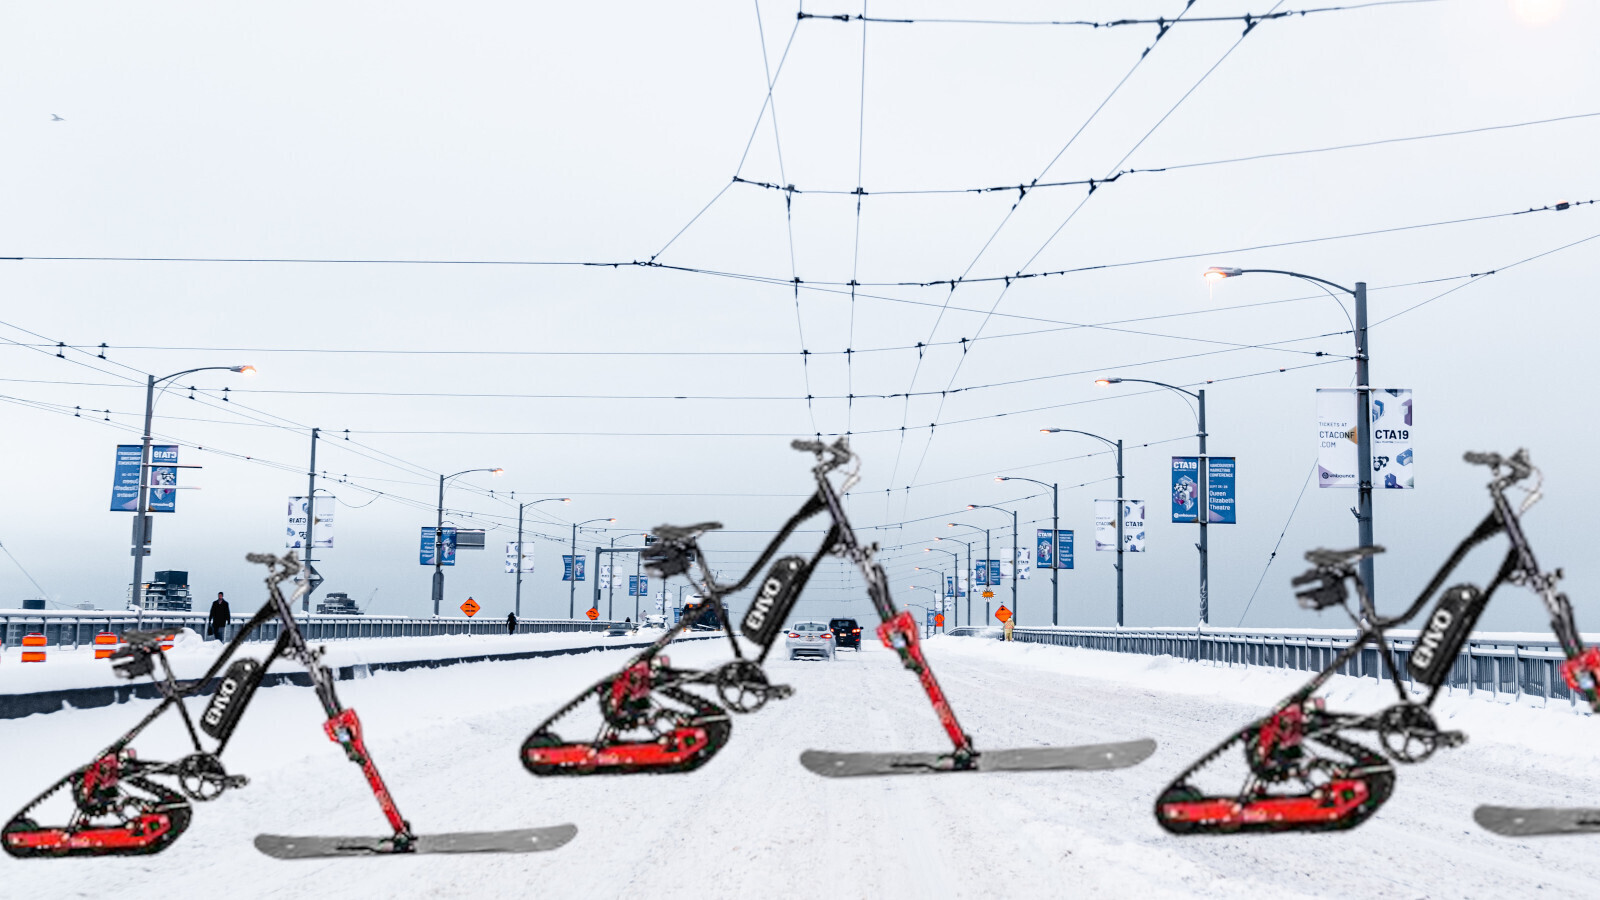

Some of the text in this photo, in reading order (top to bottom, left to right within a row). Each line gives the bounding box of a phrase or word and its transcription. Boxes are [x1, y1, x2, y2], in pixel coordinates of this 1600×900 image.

[1319, 431, 1355, 439] CTACONF
[1375, 429, 1409, 440] CTA19
[1173, 461, 1197, 469] CTA19
[745, 577, 782, 631] ENVO
[1411, 607, 1452, 669] ENVO
[204, 677, 238, 726] ENVO
